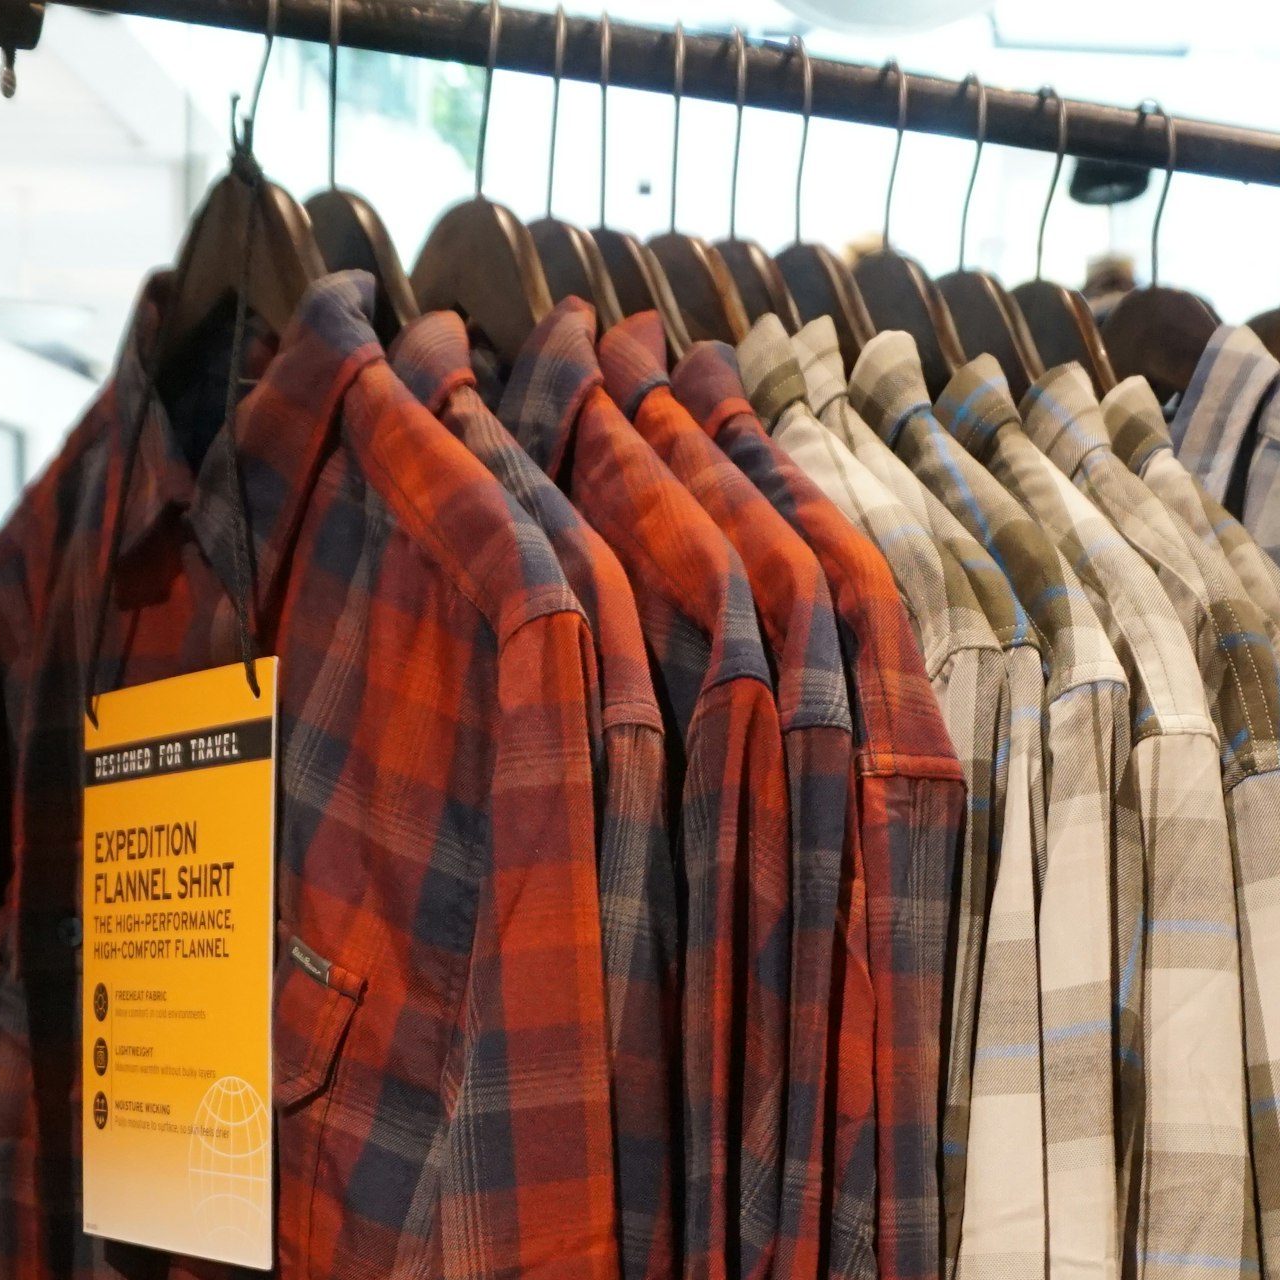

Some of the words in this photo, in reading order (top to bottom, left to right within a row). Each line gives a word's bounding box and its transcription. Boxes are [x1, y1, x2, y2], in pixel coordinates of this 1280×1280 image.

[95, 748, 151, 778] DESIGNED
[159, 741, 182, 767] FOR
[190, 732, 239, 762] TRAVEL
[95, 820, 197, 864] EXPEDITION
[95, 868, 172, 904] FLANNEL
[177, 861, 235, 900] SHIRT
[94, 915, 113, 934] THE
[115, 908, 235, 933] HIGH-PERFORMANCE,
[94, 939, 172, 960] HIGH-COMFORT
[175, 937, 229, 958] FLANNEL
[145, 990, 167, 1002] FABRIC
[115, 1045, 154, 1058] LIGHTWEIGHT
[198, 1067, 216, 1080] layers
[115, 1100, 143, 1113] MOISTURE
[145, 1103, 171, 1116] WICKING
